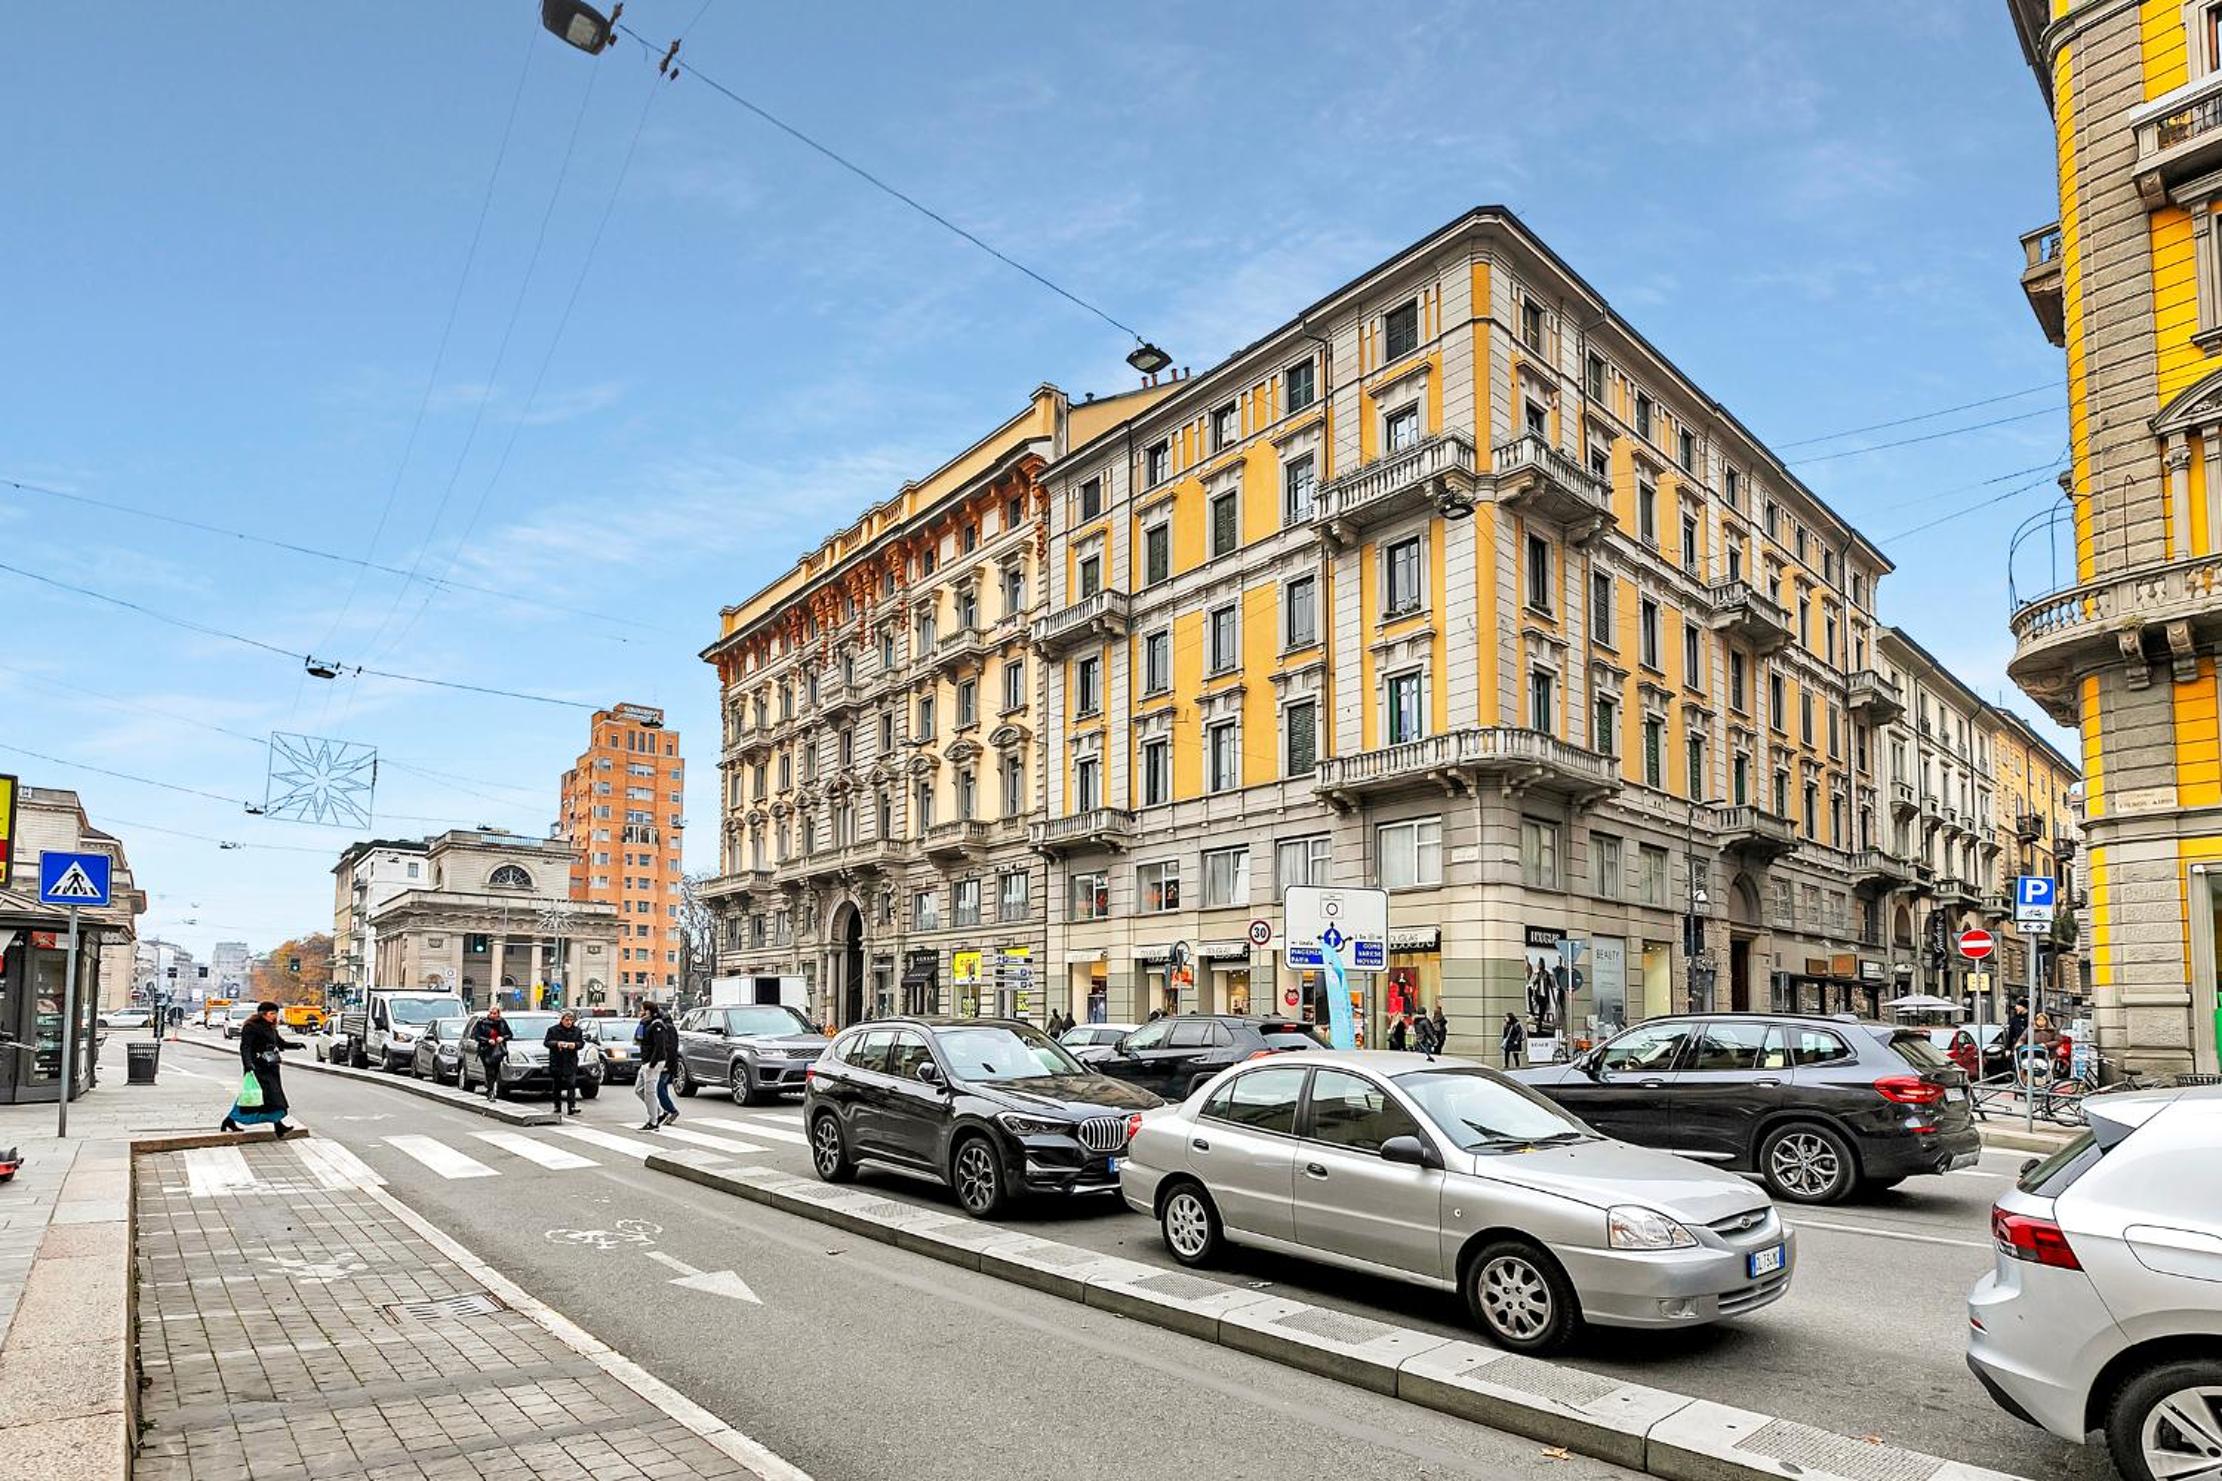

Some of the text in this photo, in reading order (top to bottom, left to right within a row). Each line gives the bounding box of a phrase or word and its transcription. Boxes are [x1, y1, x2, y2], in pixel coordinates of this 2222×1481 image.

[2025, 879, 2048, 903] P
[1253, 926, 1267, 939] 30
[1595, 948, 1620, 961] BEAUTY
